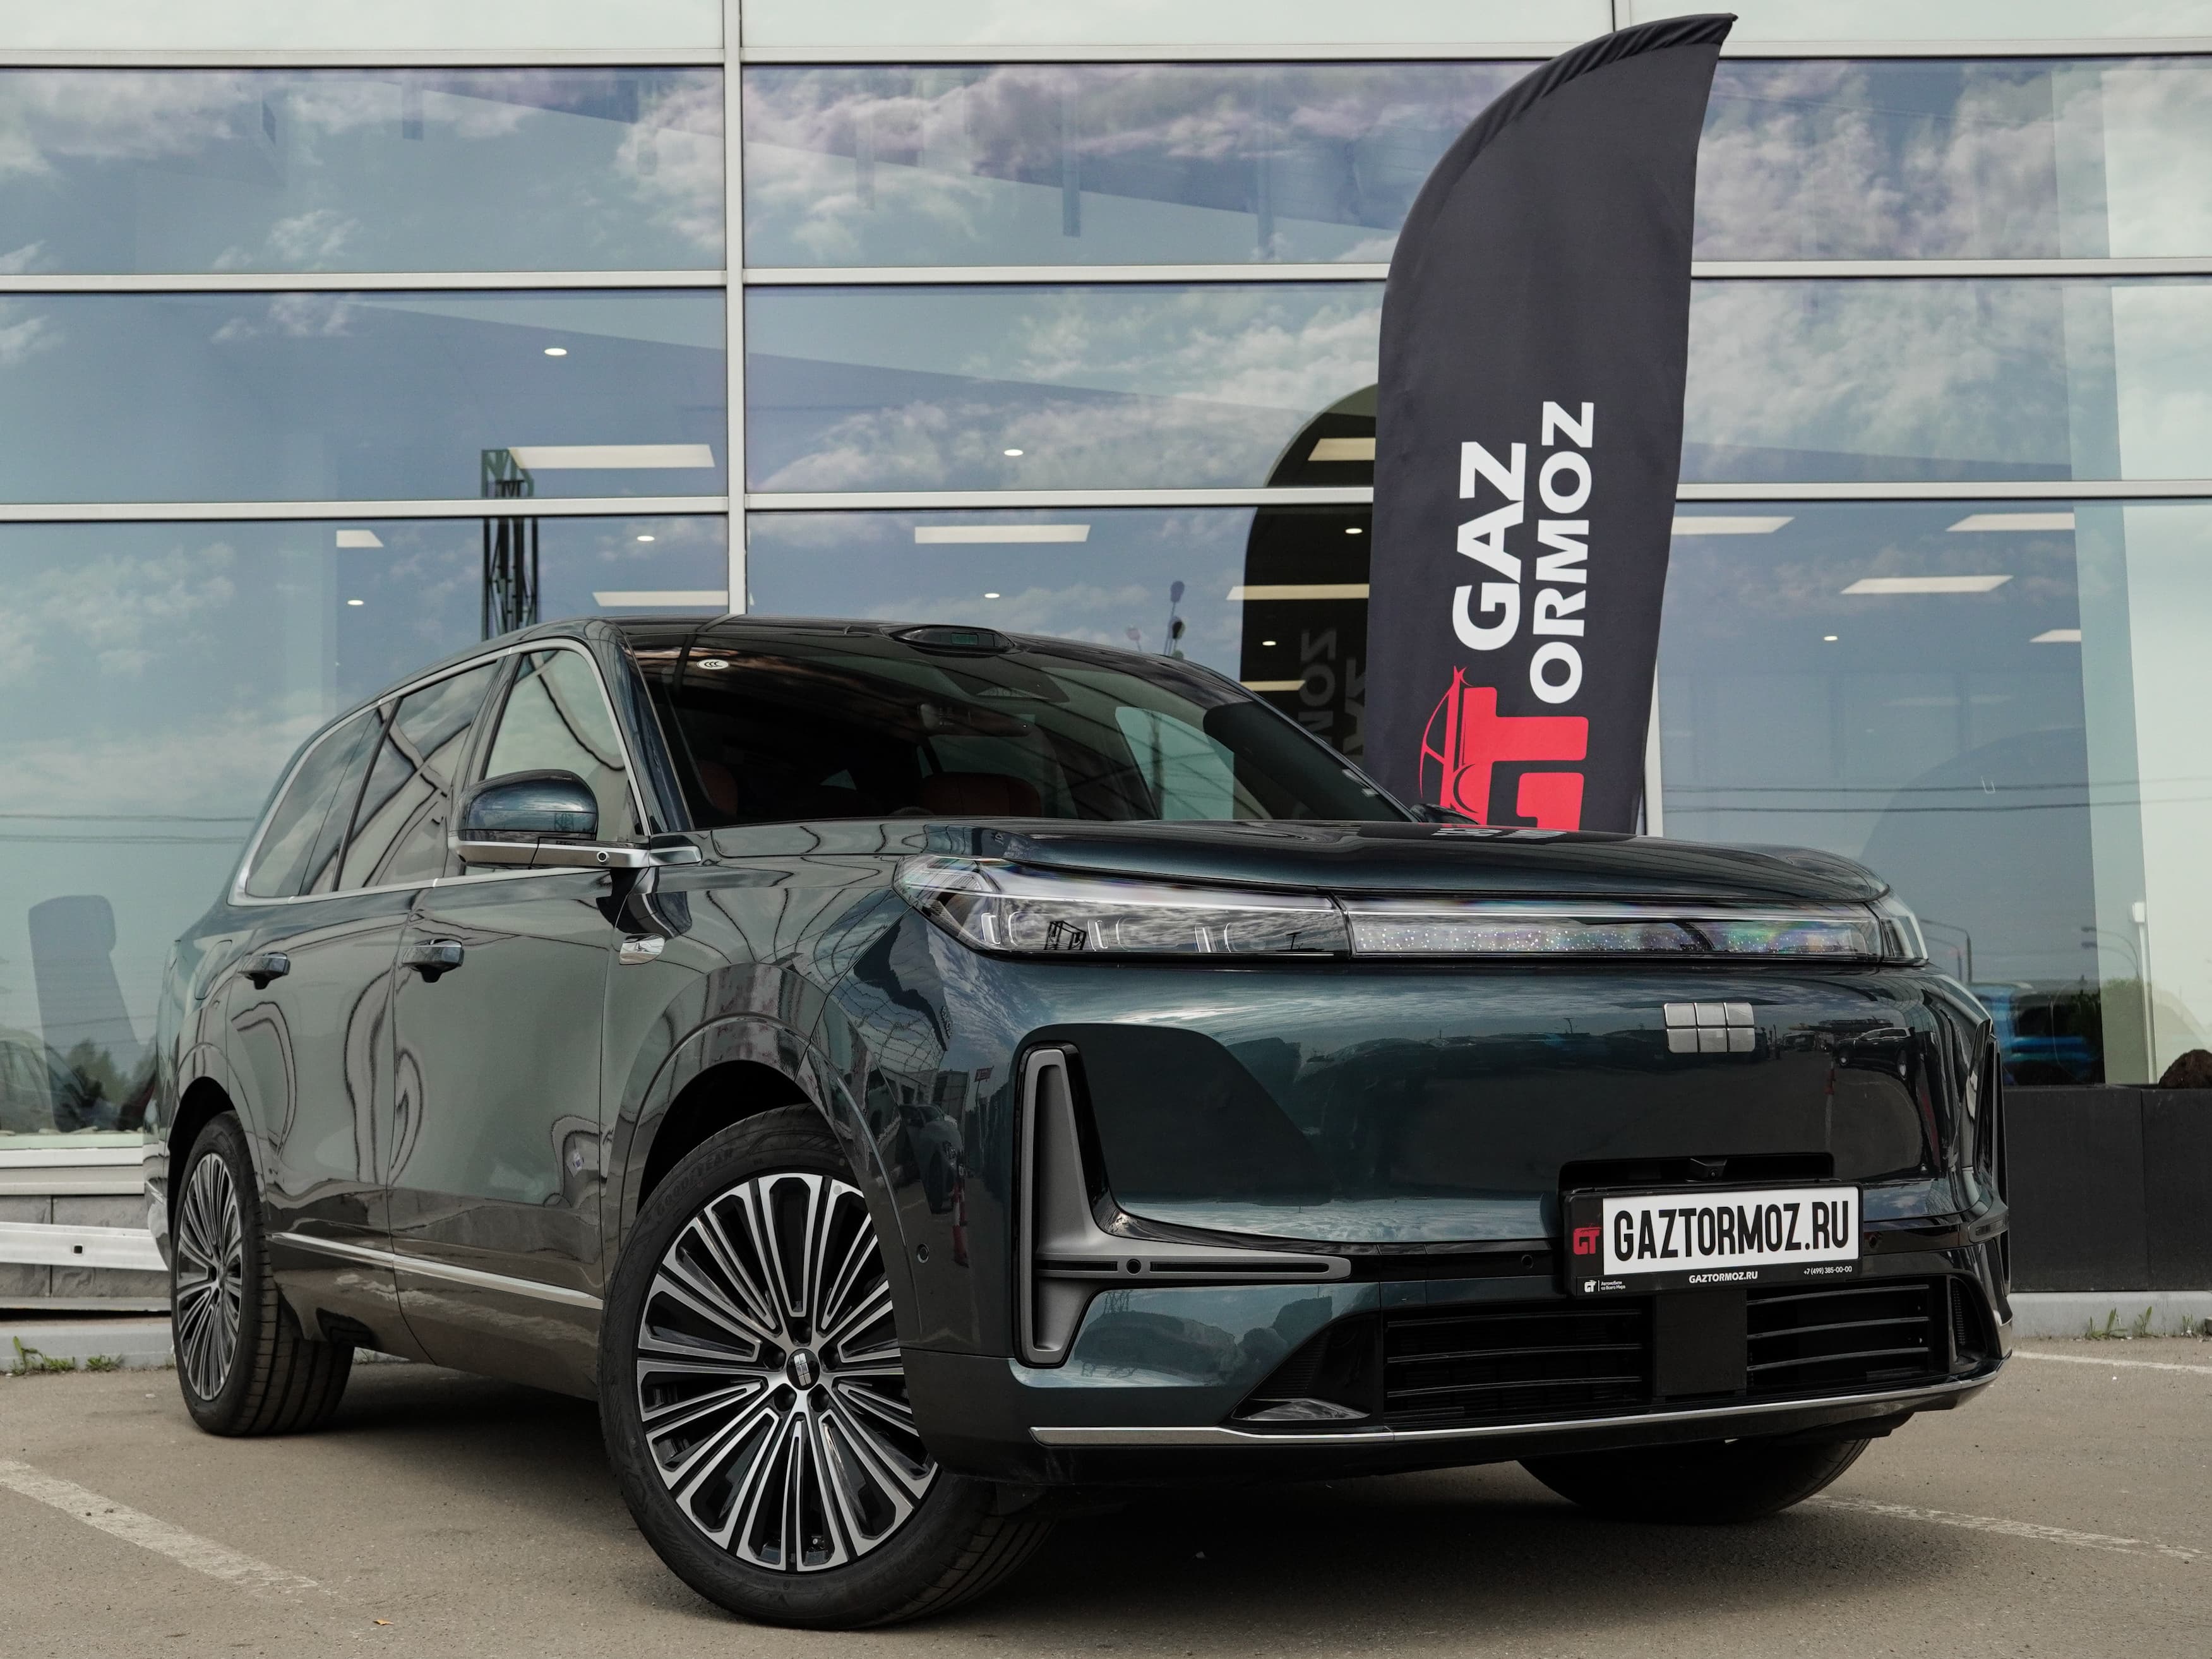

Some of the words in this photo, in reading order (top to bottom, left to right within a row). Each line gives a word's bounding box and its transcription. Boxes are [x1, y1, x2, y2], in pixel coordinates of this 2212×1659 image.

[1452, 441, 1526, 650] GAZ
[1529, 401, 1594, 704] ORMOZ
[1573, 1226, 1601, 1255] GT
[1614, 1201, 1849, 1261] GAZTORMOZ.RU
[1584, 1280, 1597, 1292] GT
[1689, 1271, 1758, 1283] GAZTORMOZ.RU
